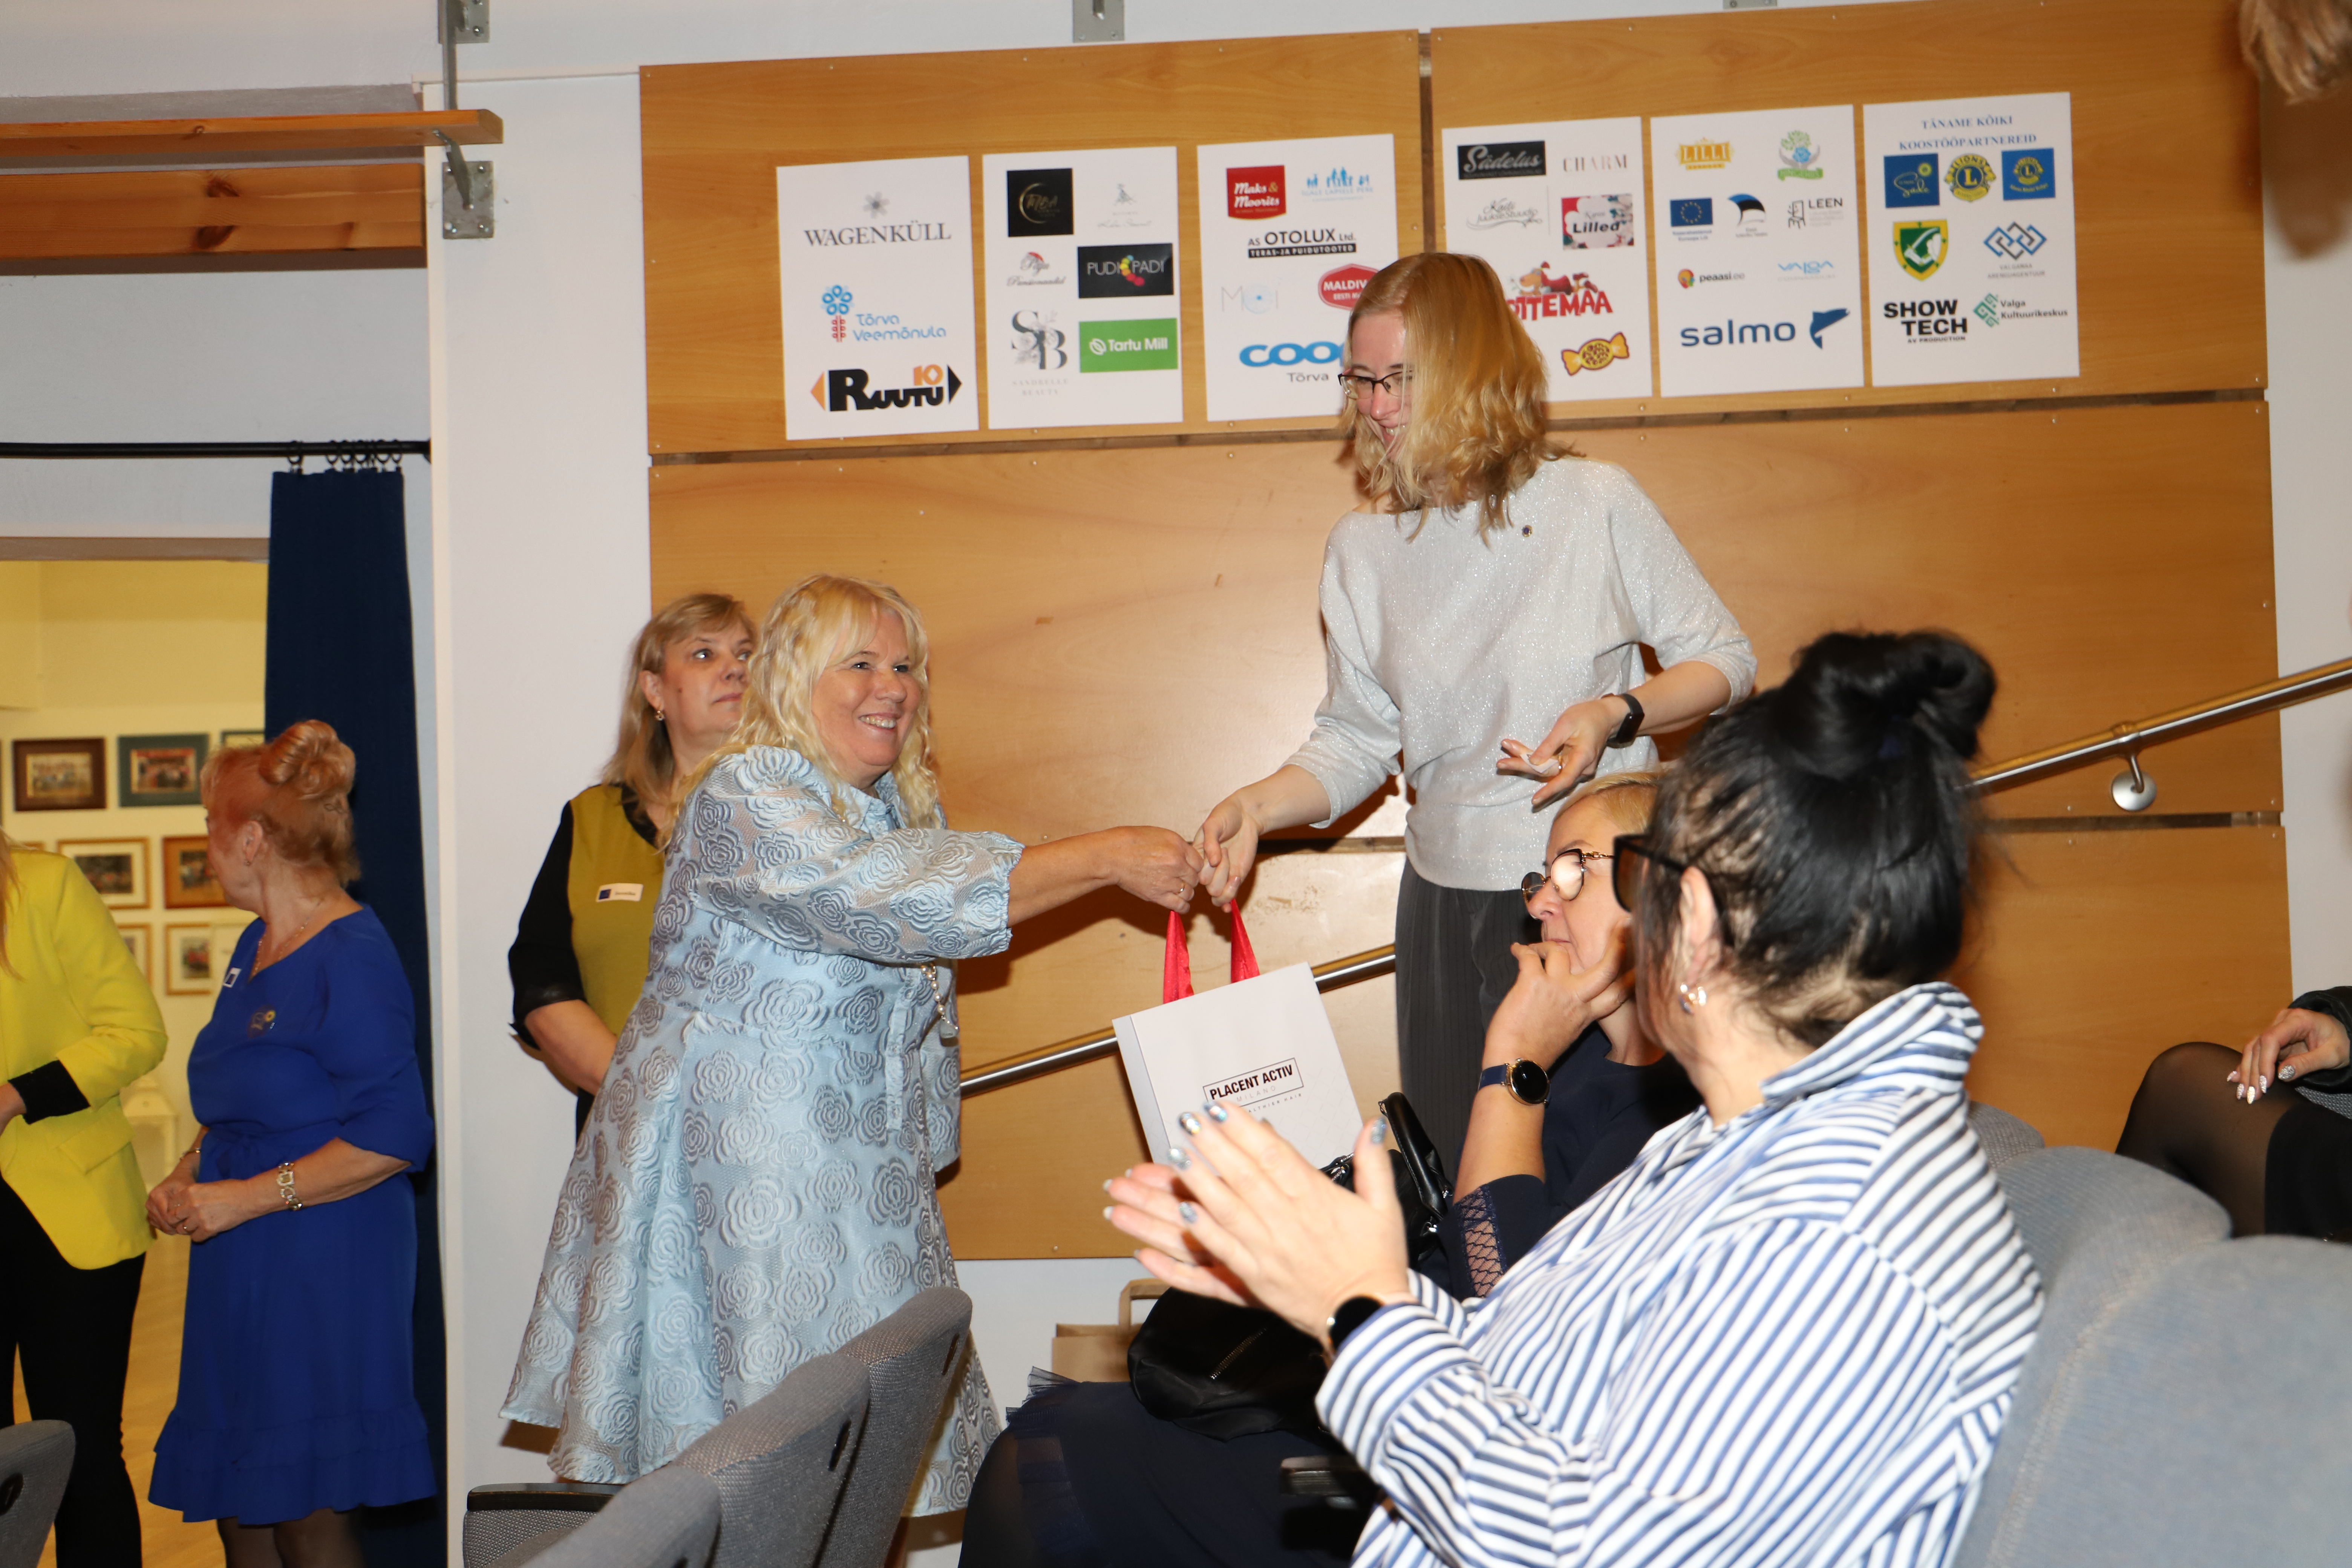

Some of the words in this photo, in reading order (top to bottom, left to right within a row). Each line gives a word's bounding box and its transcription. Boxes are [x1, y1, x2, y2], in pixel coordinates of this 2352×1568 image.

[1921, 116, 1972, 129] TÄNAME
[1977, 114, 2013, 126] KÕIKI
[1899, 134, 2037, 150] KOOSTÖÖPARTNEREID
[1683, 144, 1727, 161] LILLI
[1563, 155, 1627, 172] CHARM
[1955, 155, 1985, 167] LIONS
[1964, 168, 1977, 186] L
[1234, 182, 1267, 194] Maks
[1269, 181, 1279, 192] &
[1234, 195, 1280, 208] Moorits
[1809, 197, 1842, 209] LEEN
[803, 220, 951, 247] WAGENKÜLL
[1573, 221, 1620, 234] Lilled
[1265, 228, 1335, 245] OTOLUX
[1339, 232, 1356, 242] Ltd.
[1292, 245, 1354, 255] PUIDUTOOTED
[1087, 262, 1120, 277] PUDI
[1132, 260, 1164, 274] PADI
[1324, 279, 1368, 291] MALDIV
[1699, 271, 1745, 283] peaasi.ee
[1506, 289, 1613, 320] TTEMAA
[1883, 299, 1958, 318] SHOW
[2000, 299, 2026, 308] Valga
[856, 313, 899, 326] Tõrva
[2001, 309, 2068, 319] Kultuurikeskus
[853, 324, 946, 341] Veemõnula
[1680, 319, 1796, 347] salmo
[1902, 318, 1968, 336] TECH
[1109, 338, 1141, 352] Tartu
[1145, 337, 1168, 350] Mill
[1239, 341, 1344, 367] coo
[913, 364, 944, 386] 10
[1287, 372, 1329, 383] Tõrva
[1210, 1075, 1259, 1099] PLACENT
[1262, 1064, 1293, 1084] ACTIV
[1236, 1086, 1276, 1102] MILANO
[1248, 1100, 1280, 1113] ALTHIER
[1284, 1093, 1302, 1102] HAIR
